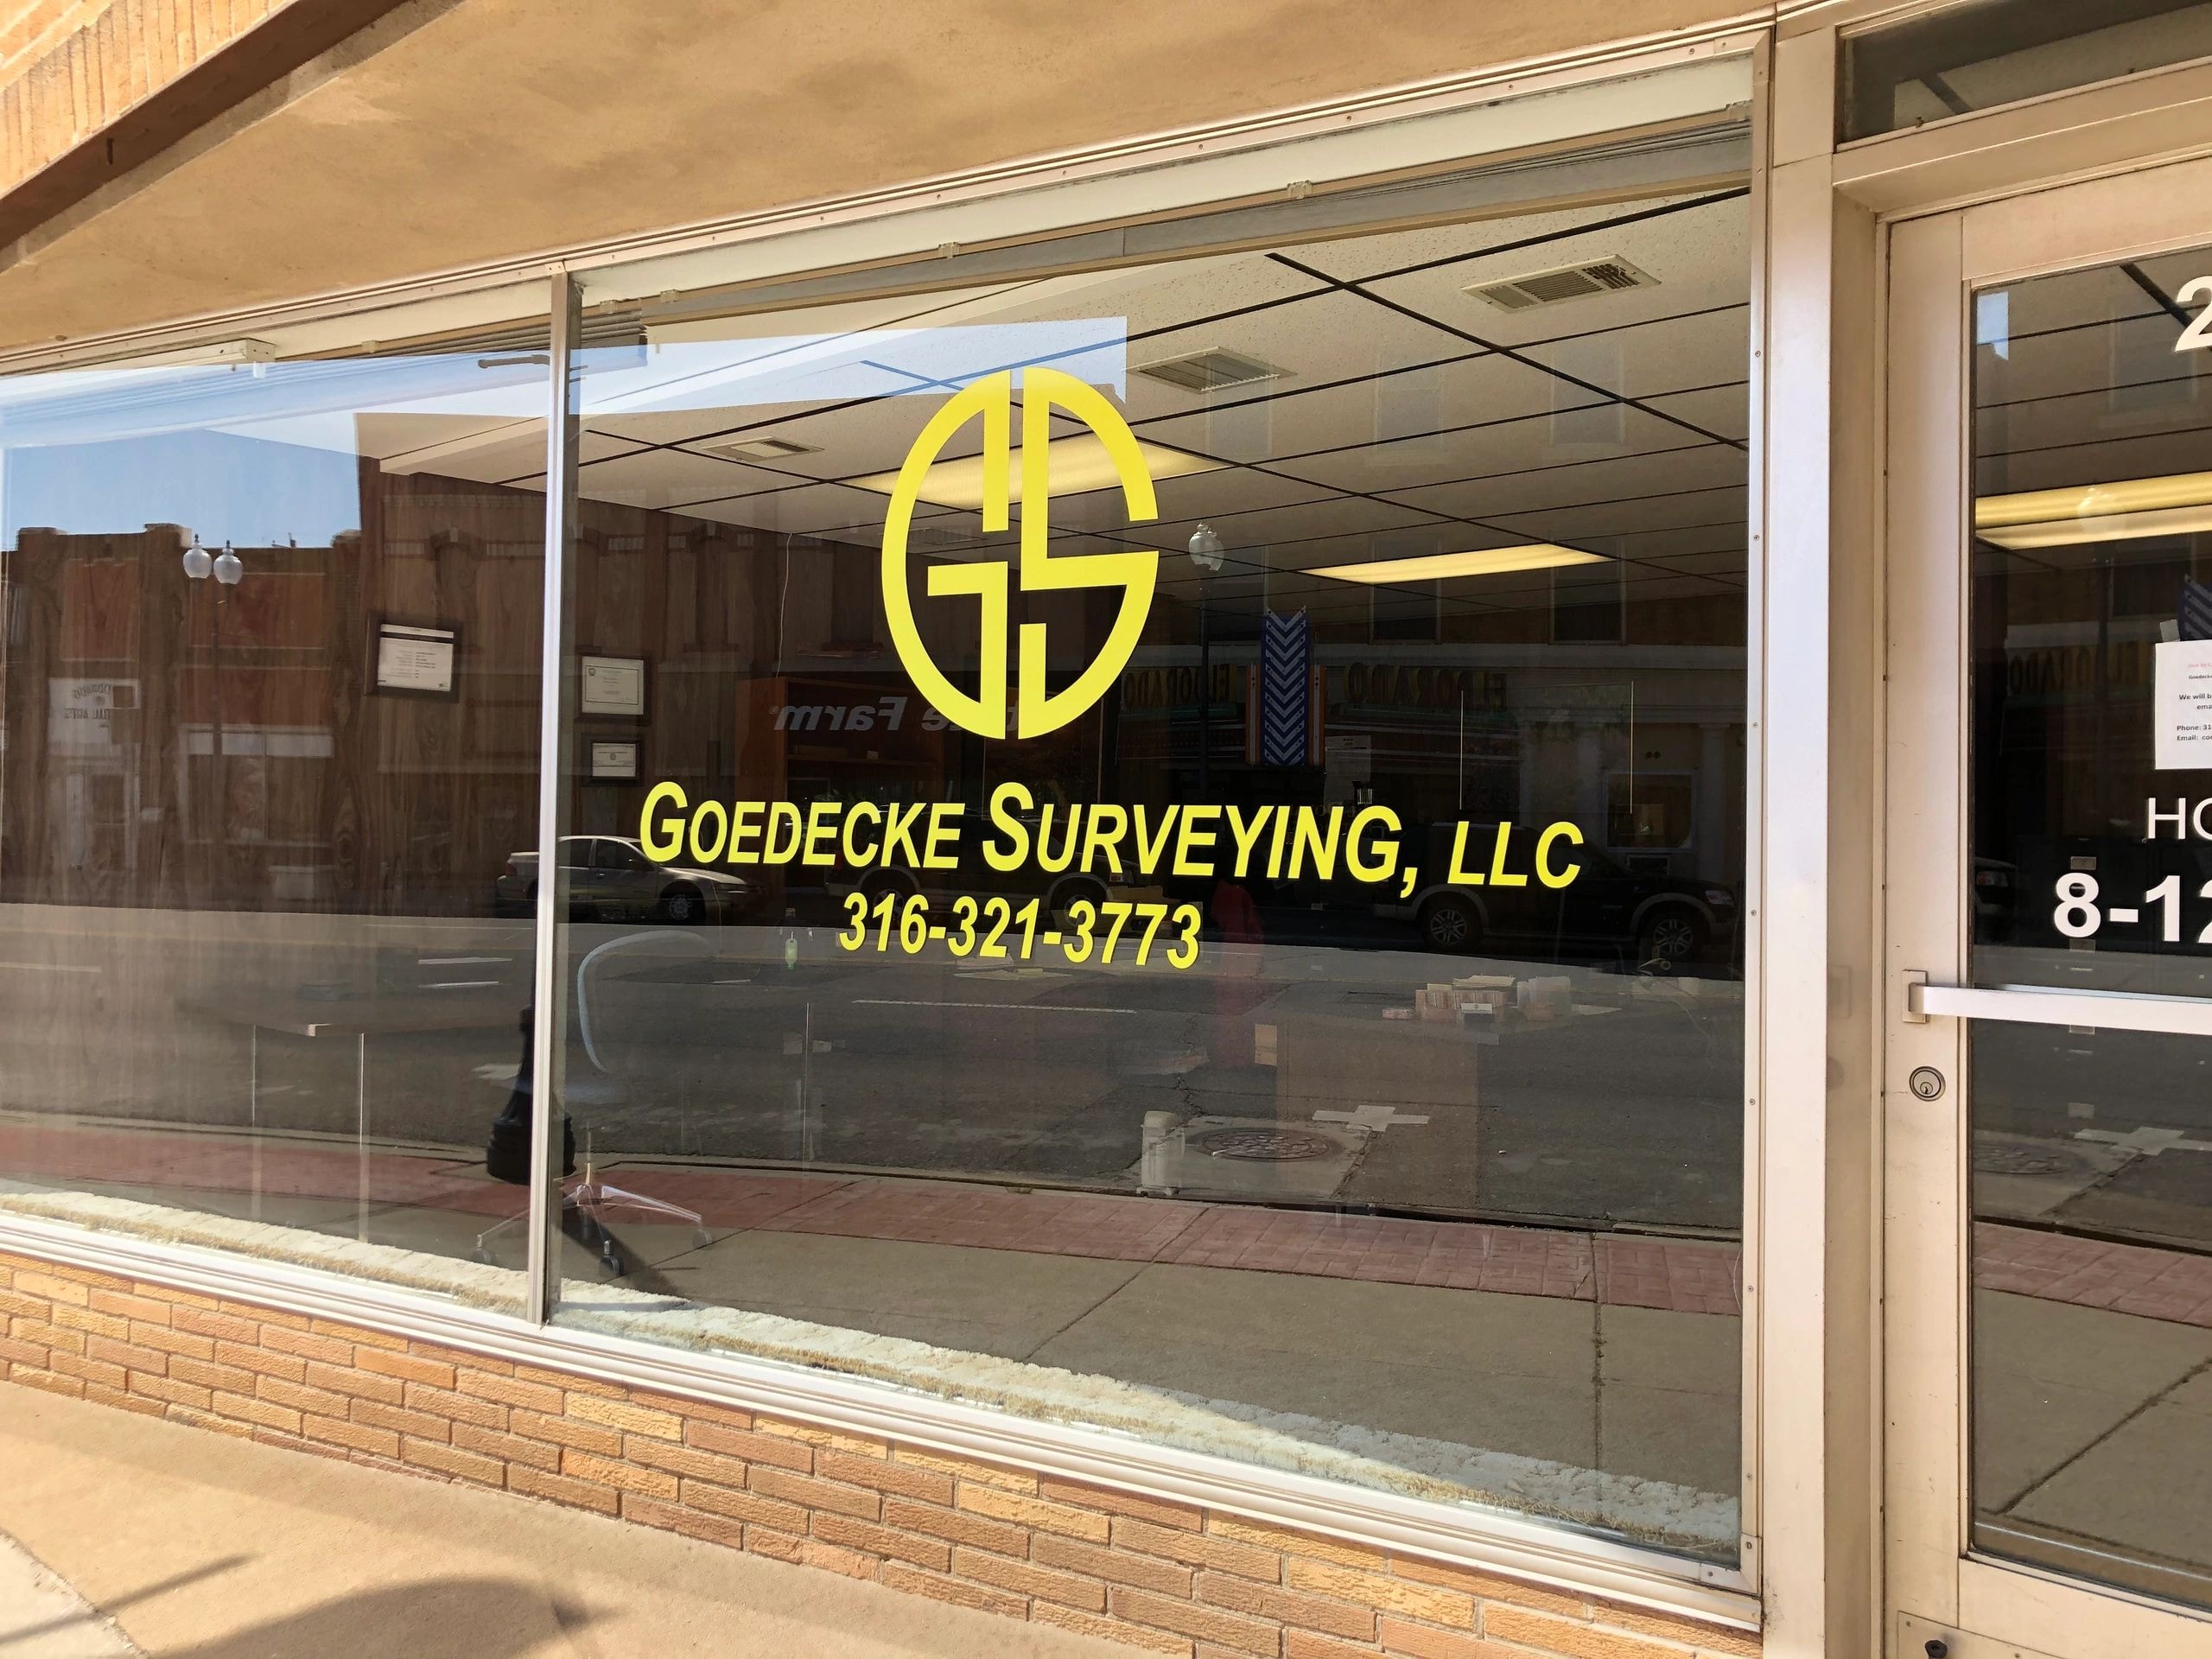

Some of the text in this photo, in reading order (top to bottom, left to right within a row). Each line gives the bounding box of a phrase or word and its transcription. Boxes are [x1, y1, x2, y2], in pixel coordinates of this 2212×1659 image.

[639, 781, 1584, 897] GOEDECKE SURVEYING, LLC
[839, 892, 1201, 969] 316-321-3773
